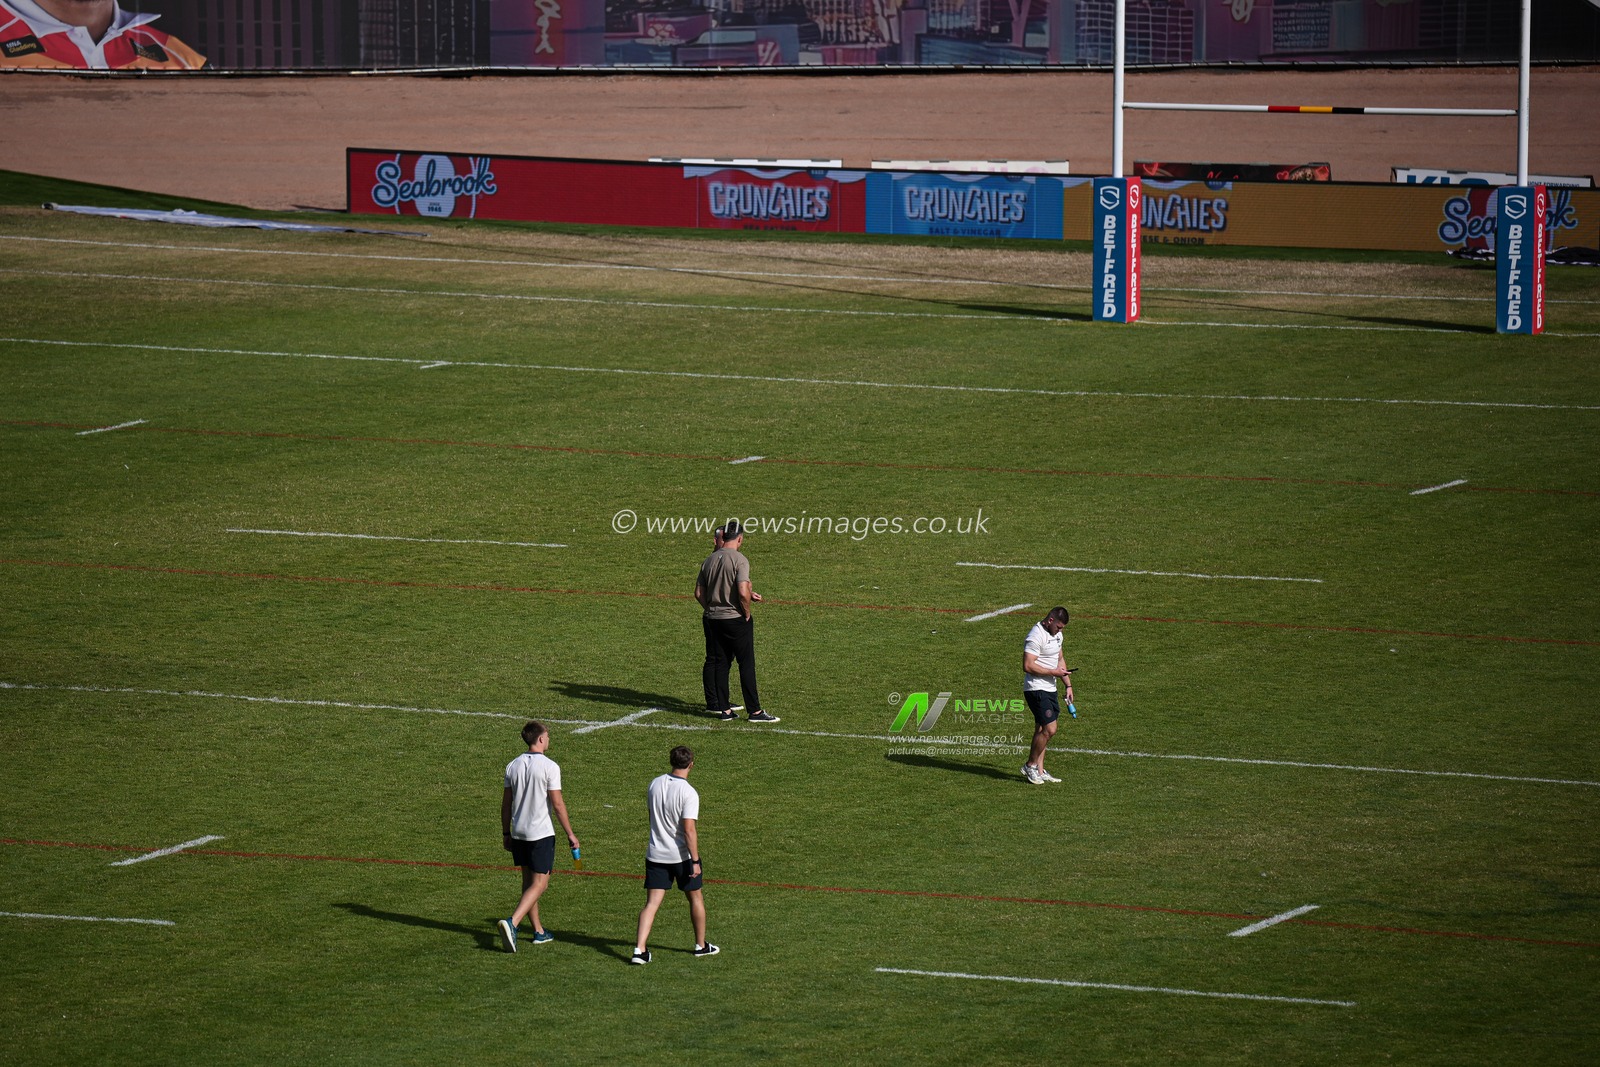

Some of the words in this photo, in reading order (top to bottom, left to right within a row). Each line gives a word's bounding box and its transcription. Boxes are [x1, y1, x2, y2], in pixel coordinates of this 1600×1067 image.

[371, 157, 497, 208] Seabrook
[709, 181, 830, 221] CRUNCHIES
[904, 186, 1028, 225] CRUNCHIES
[929, 227, 950, 235] SALT
[961, 228, 1001, 237] VINEGAR
[1173, 236, 1205, 245] ONION
[1103, 215, 1117, 318] BETFRED
[1507, 225, 1522, 329] BETFRED
